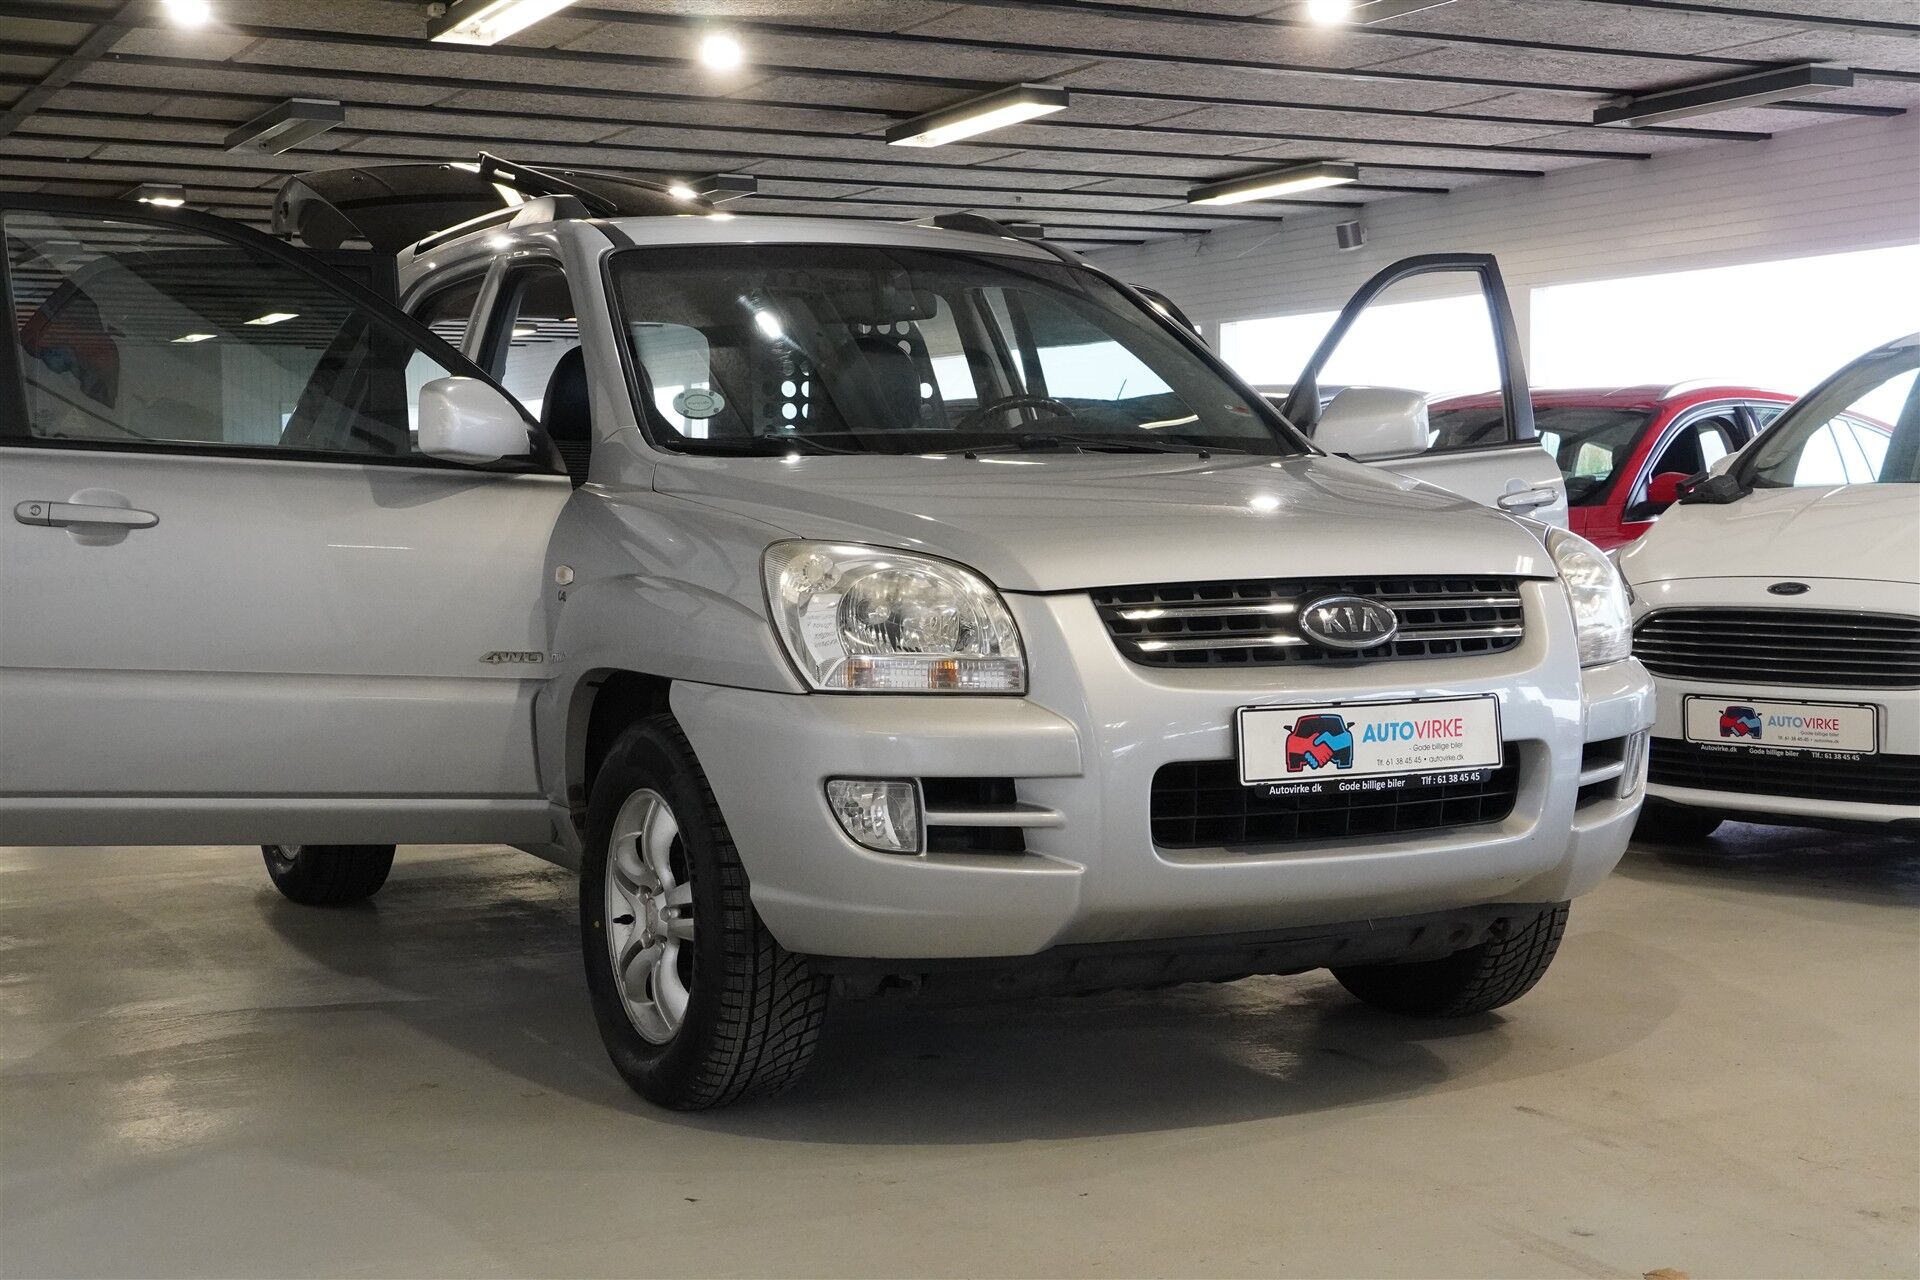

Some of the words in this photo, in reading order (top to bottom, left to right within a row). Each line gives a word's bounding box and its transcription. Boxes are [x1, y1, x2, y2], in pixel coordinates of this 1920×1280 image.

[1317, 607, 1386, 633] KIA
[479, 651, 543, 664] 4WD
[1768, 715, 1839, 731] AUTOVIRKE
[1362, 718, 1463, 743] AUTOVIRKE
[1412, 743, 1430, 752] Gode
[1431, 742, 1449, 752] billige
[1450, 741, 1463, 749] biler
[1700, 744, 1738, 753] Autovirke.dk
[1766, 748, 1784, 757] billige
[1386, 758, 1394, 766] 61
[1394, 757, 1403, 765] 38
[1404, 756, 1413, 764] 45
[1413, 755, 1422, 763] 45
[1338, 781, 1360, 792] Gode
[1362, 779, 1386, 791] billige
[1387, 778, 1406, 788] biler
[1437, 774, 1446, 783] 61
[1449, 773, 1458, 783] 38
[1459, 773, 1469, 782] 45
[1470, 772, 1480, 781] 45
